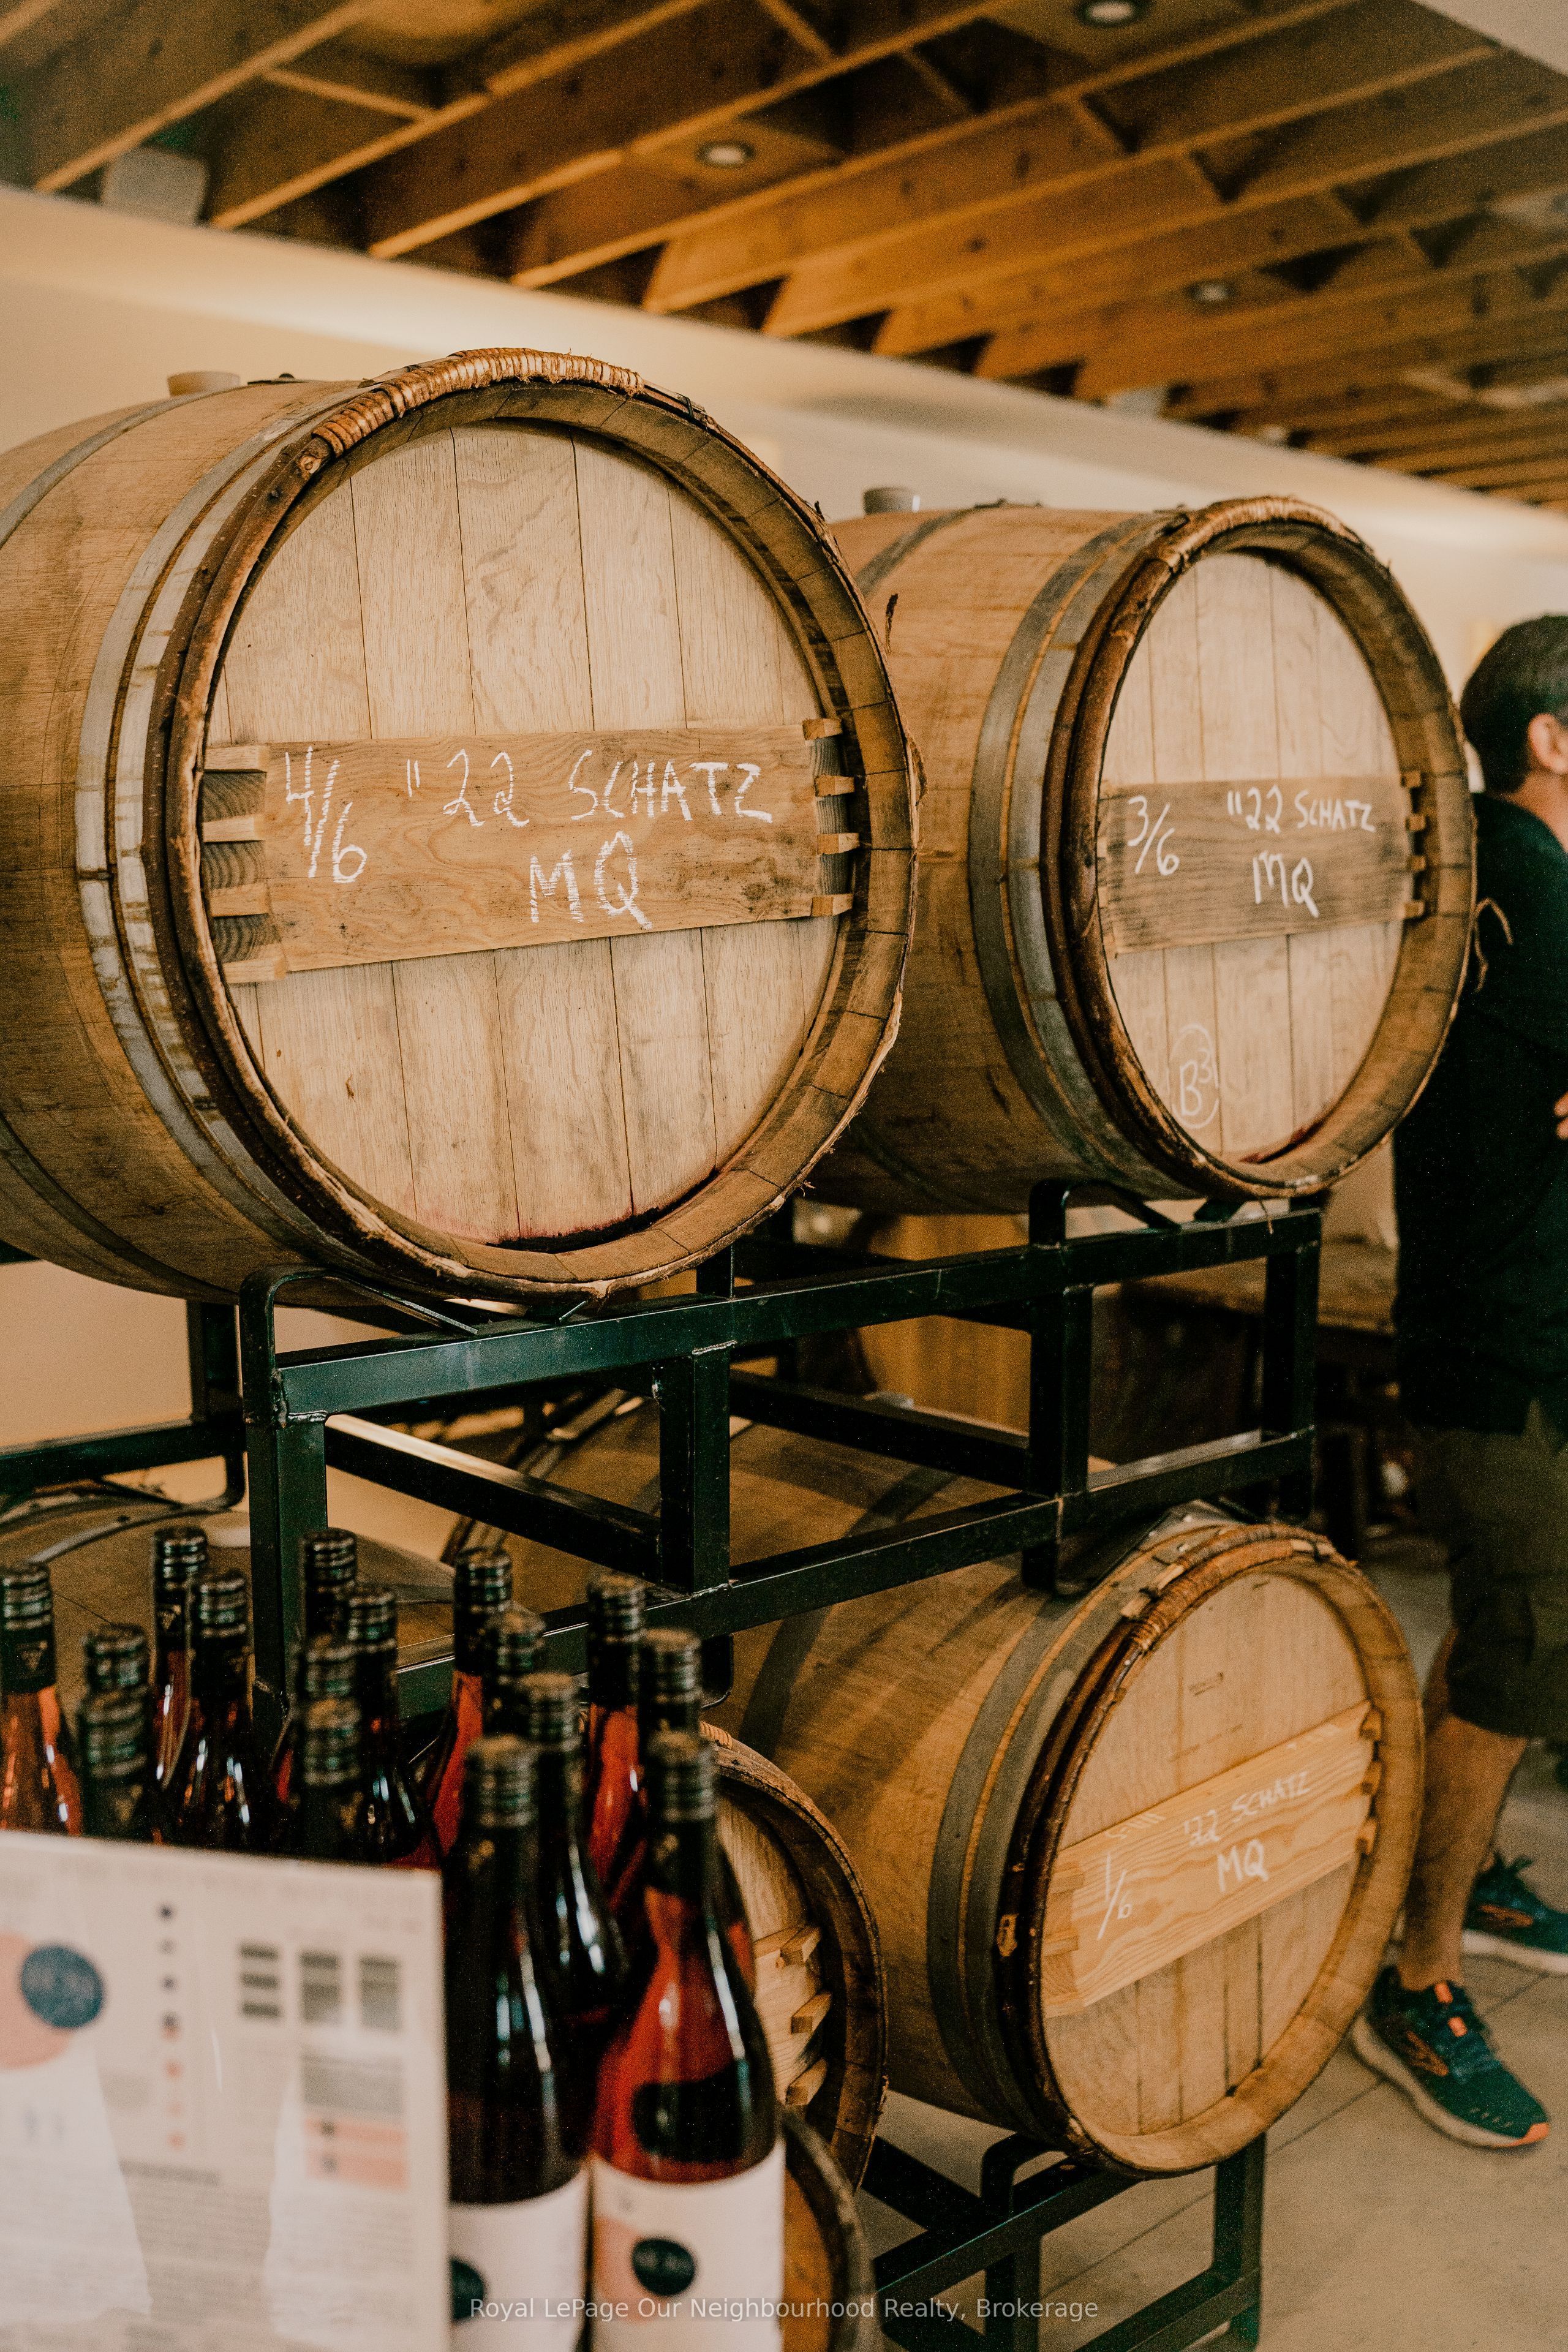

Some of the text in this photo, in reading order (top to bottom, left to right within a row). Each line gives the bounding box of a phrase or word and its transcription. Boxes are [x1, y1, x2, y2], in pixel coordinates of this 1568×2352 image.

[568, 749, 773, 823] SCHATZ
[1128, 795, 1180, 875] 3/6
[1294, 790, 1376, 832] SCHATZ
[529, 830, 654, 930] MQ
[1252, 850, 1319, 918] MQ
[1231, 1771, 1312, 1823] SCHATZ
[1216, 1839, 1270, 1893] MQ
